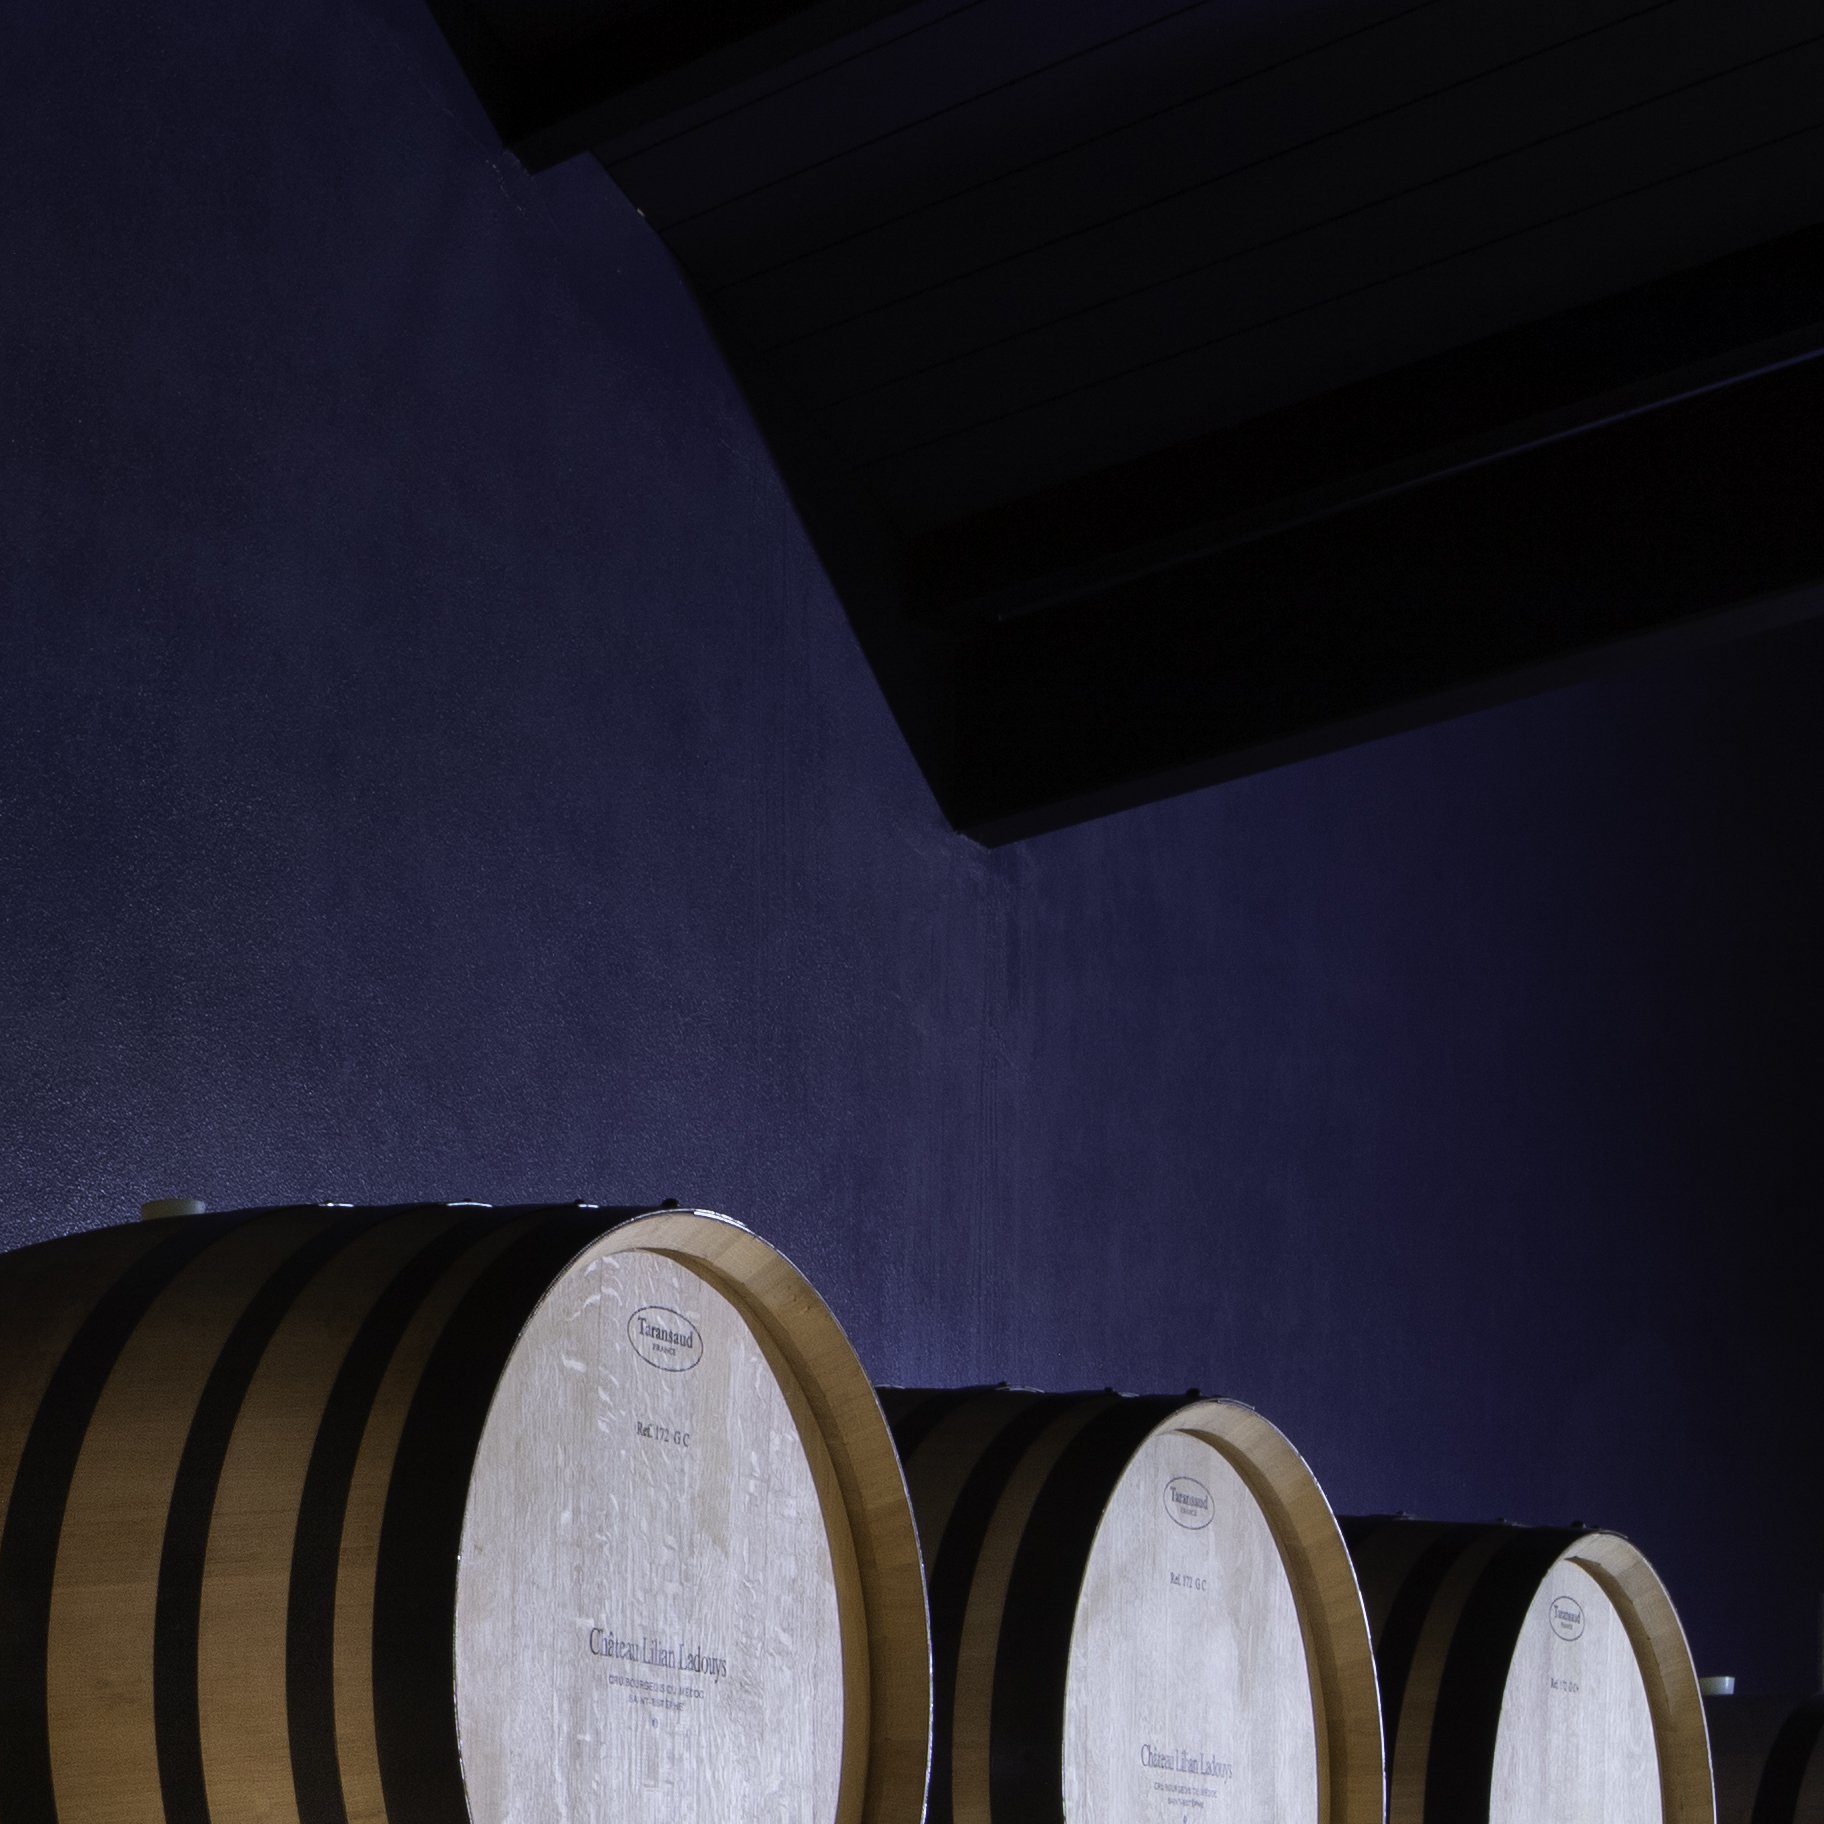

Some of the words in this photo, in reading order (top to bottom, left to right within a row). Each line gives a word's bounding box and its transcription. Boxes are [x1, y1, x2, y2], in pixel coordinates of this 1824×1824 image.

[638, 1316, 693, 1348] Taransaud
[652, 1343, 676, 1356] FRANCE
[637, 1421, 652, 1438] Ref.
[656, 1425, 669, 1442] 172
[1170, 1486, 1208, 1510] Taransaud
[590, 1628, 639, 1662] Château
[643, 1637, 675, 1669] Lilian
[679, 1644, 727, 1684] Ladouys
[609, 1675, 623, 1686] CRU
[626, 1678, 665, 1693] BOURGEOIS
[1141, 1744, 1174, 1770] Château
[1176, 1749, 1198, 1774] Lilian
[1201, 1753, 1232, 1785] Ladouys
